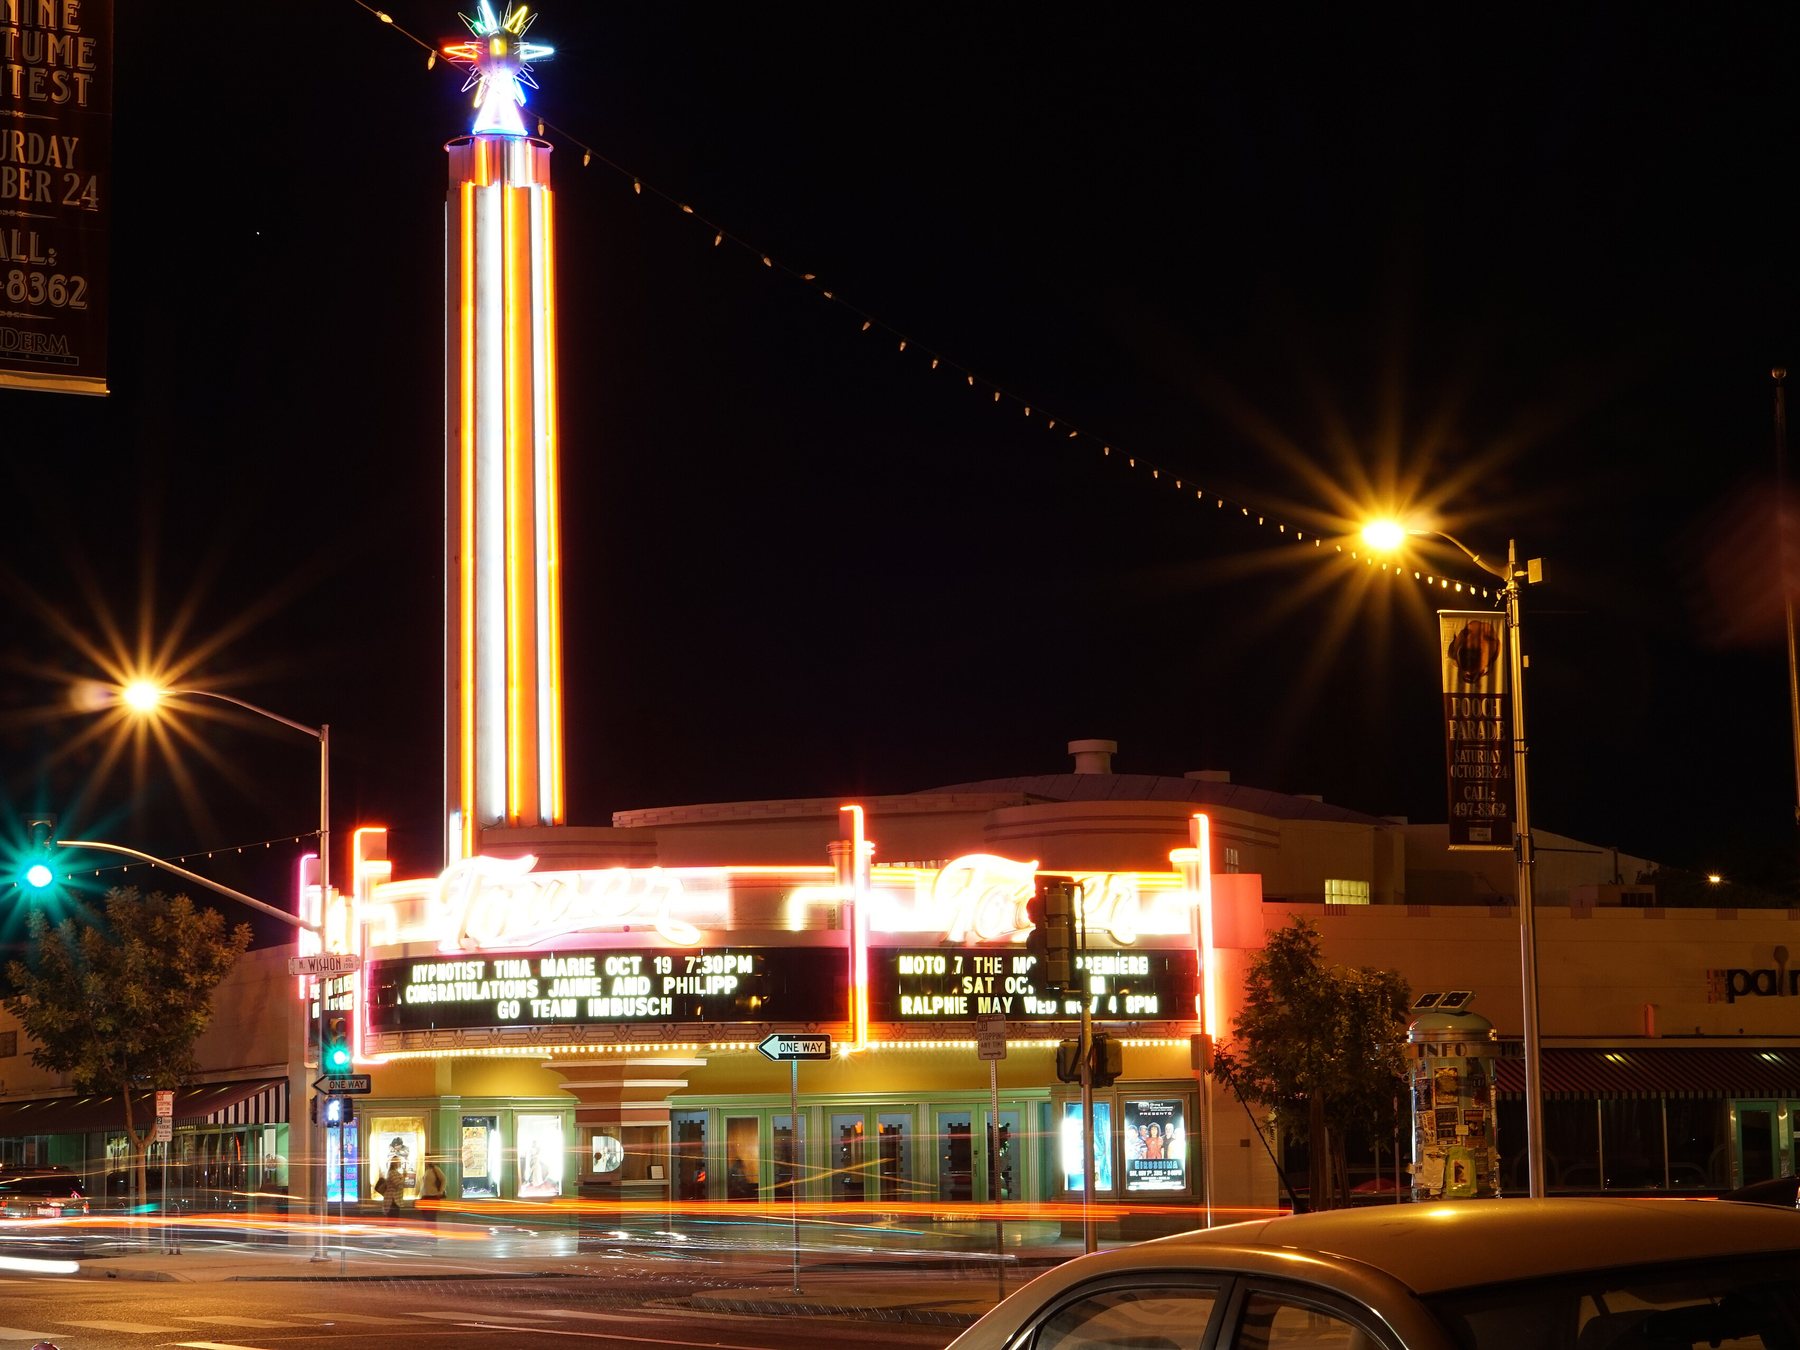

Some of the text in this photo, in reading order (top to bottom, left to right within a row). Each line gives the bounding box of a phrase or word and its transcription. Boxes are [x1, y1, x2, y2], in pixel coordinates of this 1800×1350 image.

[0, 63, 94, 108] TEST
[62, 172, 99, 210] 24
[1451, 697, 1503, 718] POOCH
[1448, 719, 1507, 741] PARADE
[1454, 748, 1503, 764] SATURDAY
[1450, 764, 1509, 779] OCTOBER 24
[1463, 785, 1496, 801] CALL:
[1453, 802, 1506, 817] 497-8362
[307, 957, 342, 972] WISHON
[412, 955, 753, 983] HYPNOTIST TINA MARIE OCT 19 7:30PM
[899, 956, 946, 975] MOTO
[953, 956, 964, 974] 7
[974, 956, 1003, 975] THE
[405, 978, 539, 1004] CONGRATULATIONS
[611, 976, 651, 996] AND
[663, 975, 738, 995] PHILIPP
[962, 976, 1035, 995] SAT OC
[497, 997, 673, 1019] GO TEAM IMBUSCH
[900, 996, 968, 1015] RALPHIE
[977, 996, 1014, 1015] MAY
[1107, 995, 1118, 1014] 4
[779, 1042, 823, 1053] ONE WAY
[1418, 1042, 1468, 1058] INFO
[329, 1080, 365, 1089] ONE WAY
